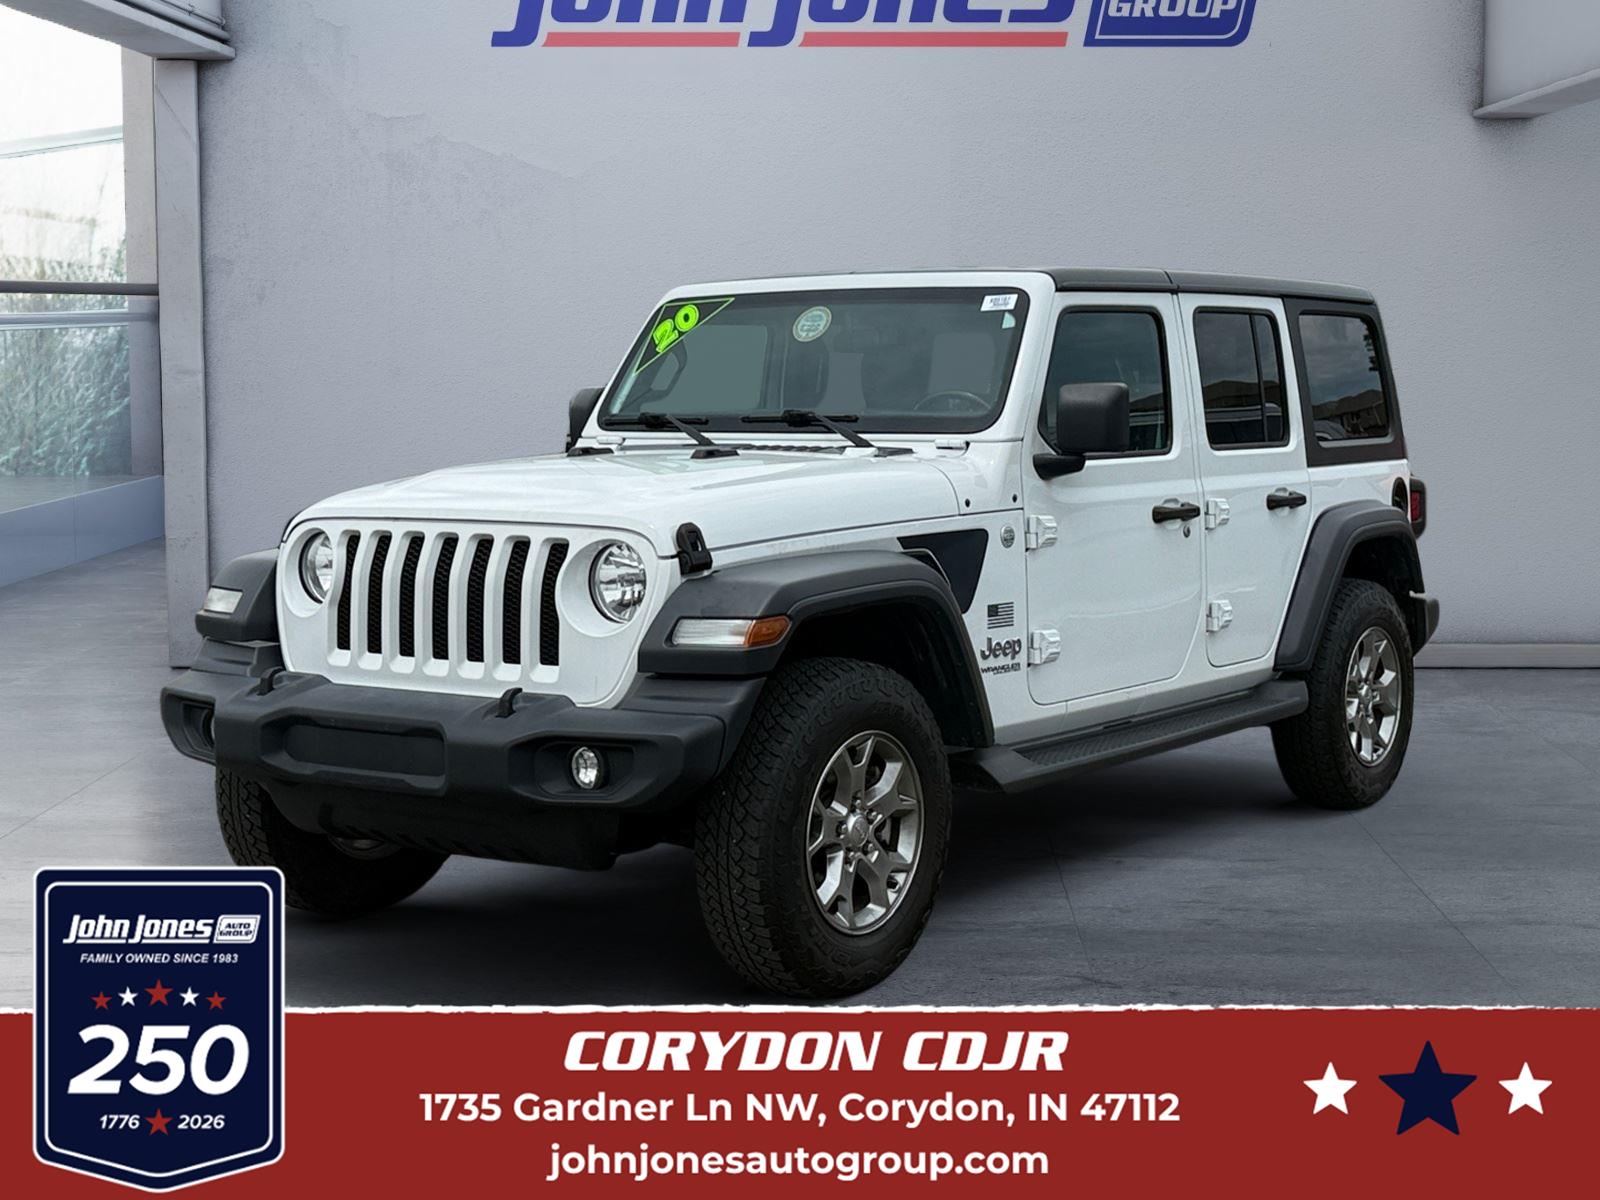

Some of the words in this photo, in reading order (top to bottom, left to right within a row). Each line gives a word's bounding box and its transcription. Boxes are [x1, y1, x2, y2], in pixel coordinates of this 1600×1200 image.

[1107, 0, 1237, 18] GROUP
[652, 304, 699, 352] 20
[980, 637, 1022, 660] Jeep
